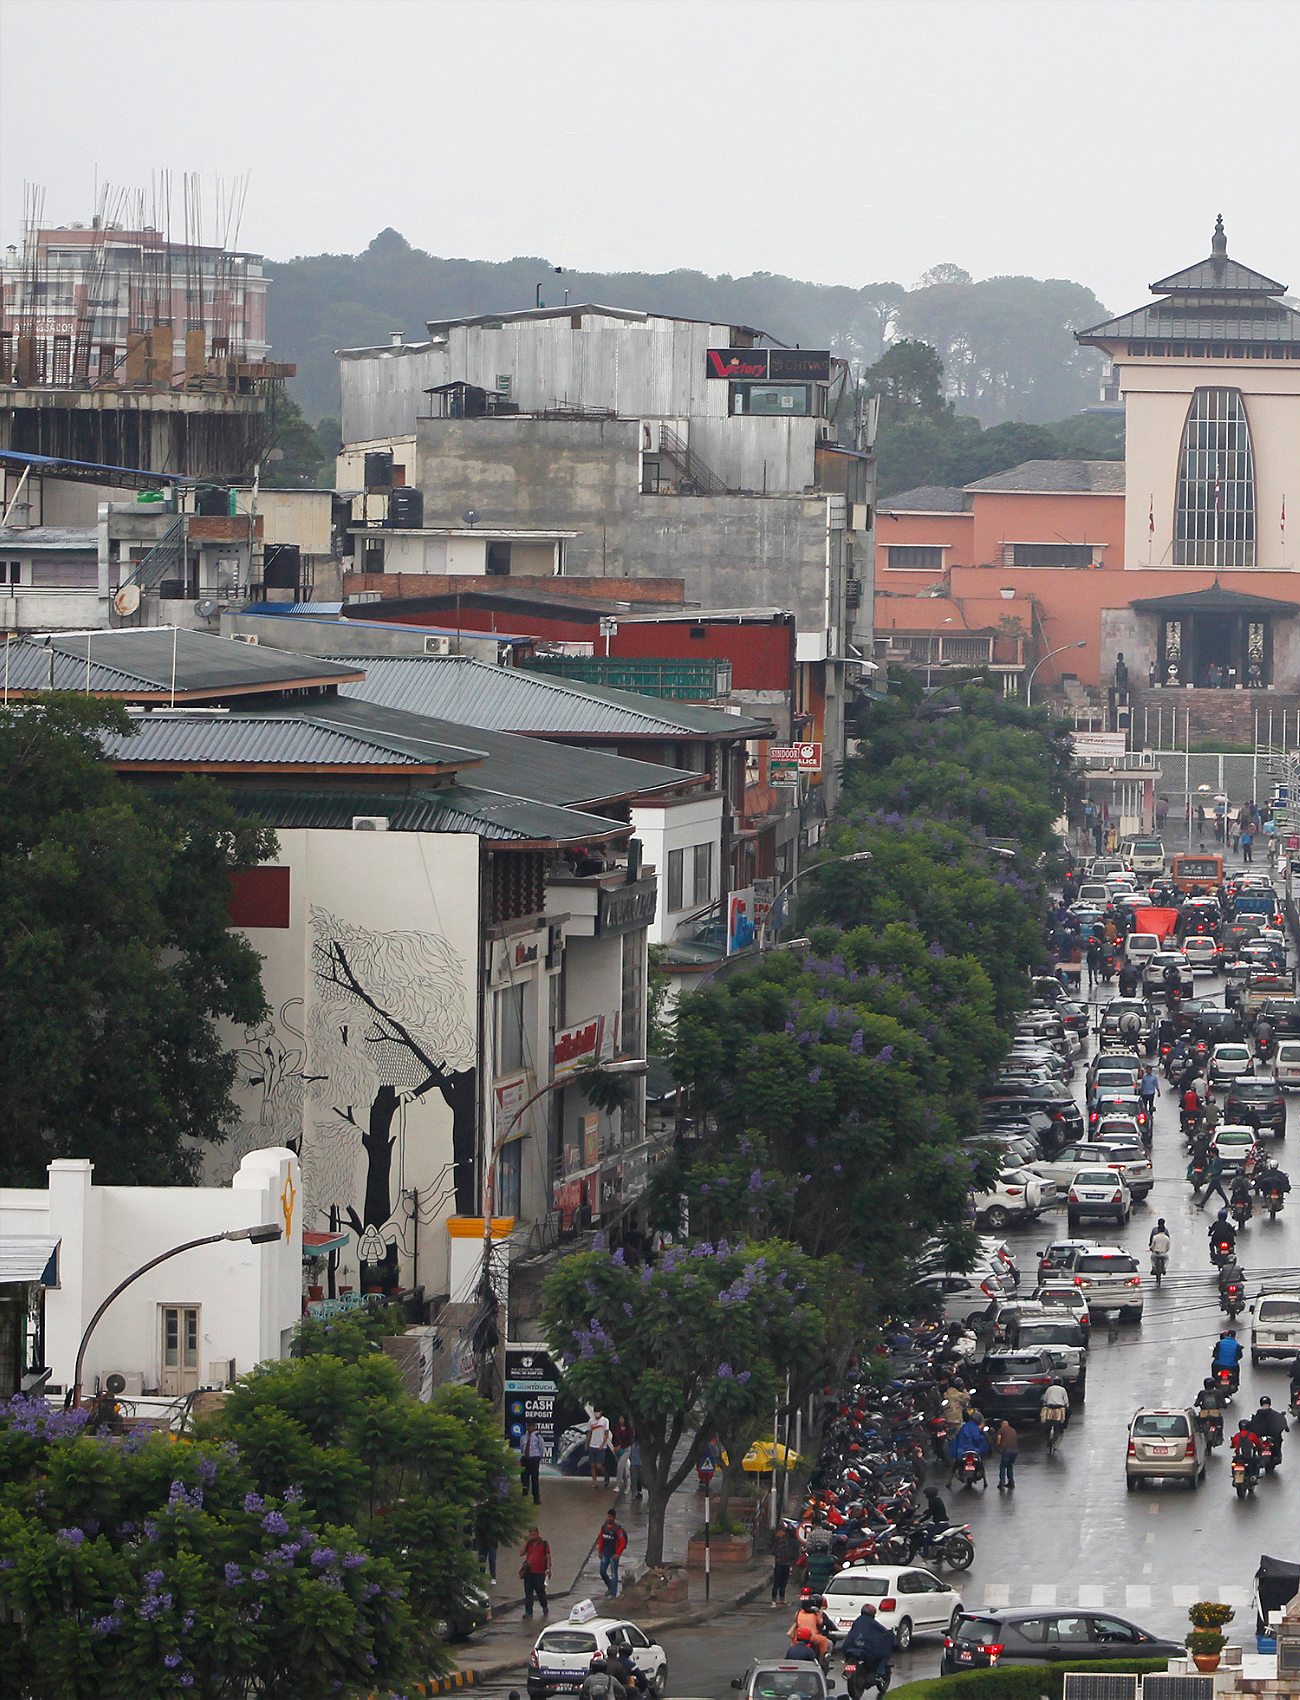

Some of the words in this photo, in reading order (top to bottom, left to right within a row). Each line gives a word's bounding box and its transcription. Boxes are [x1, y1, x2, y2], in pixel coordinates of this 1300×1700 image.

[707, 351, 767, 377] Victory
[771, 749, 798, 758] SINDOOR
[525, 1401, 553, 1410] CASH
